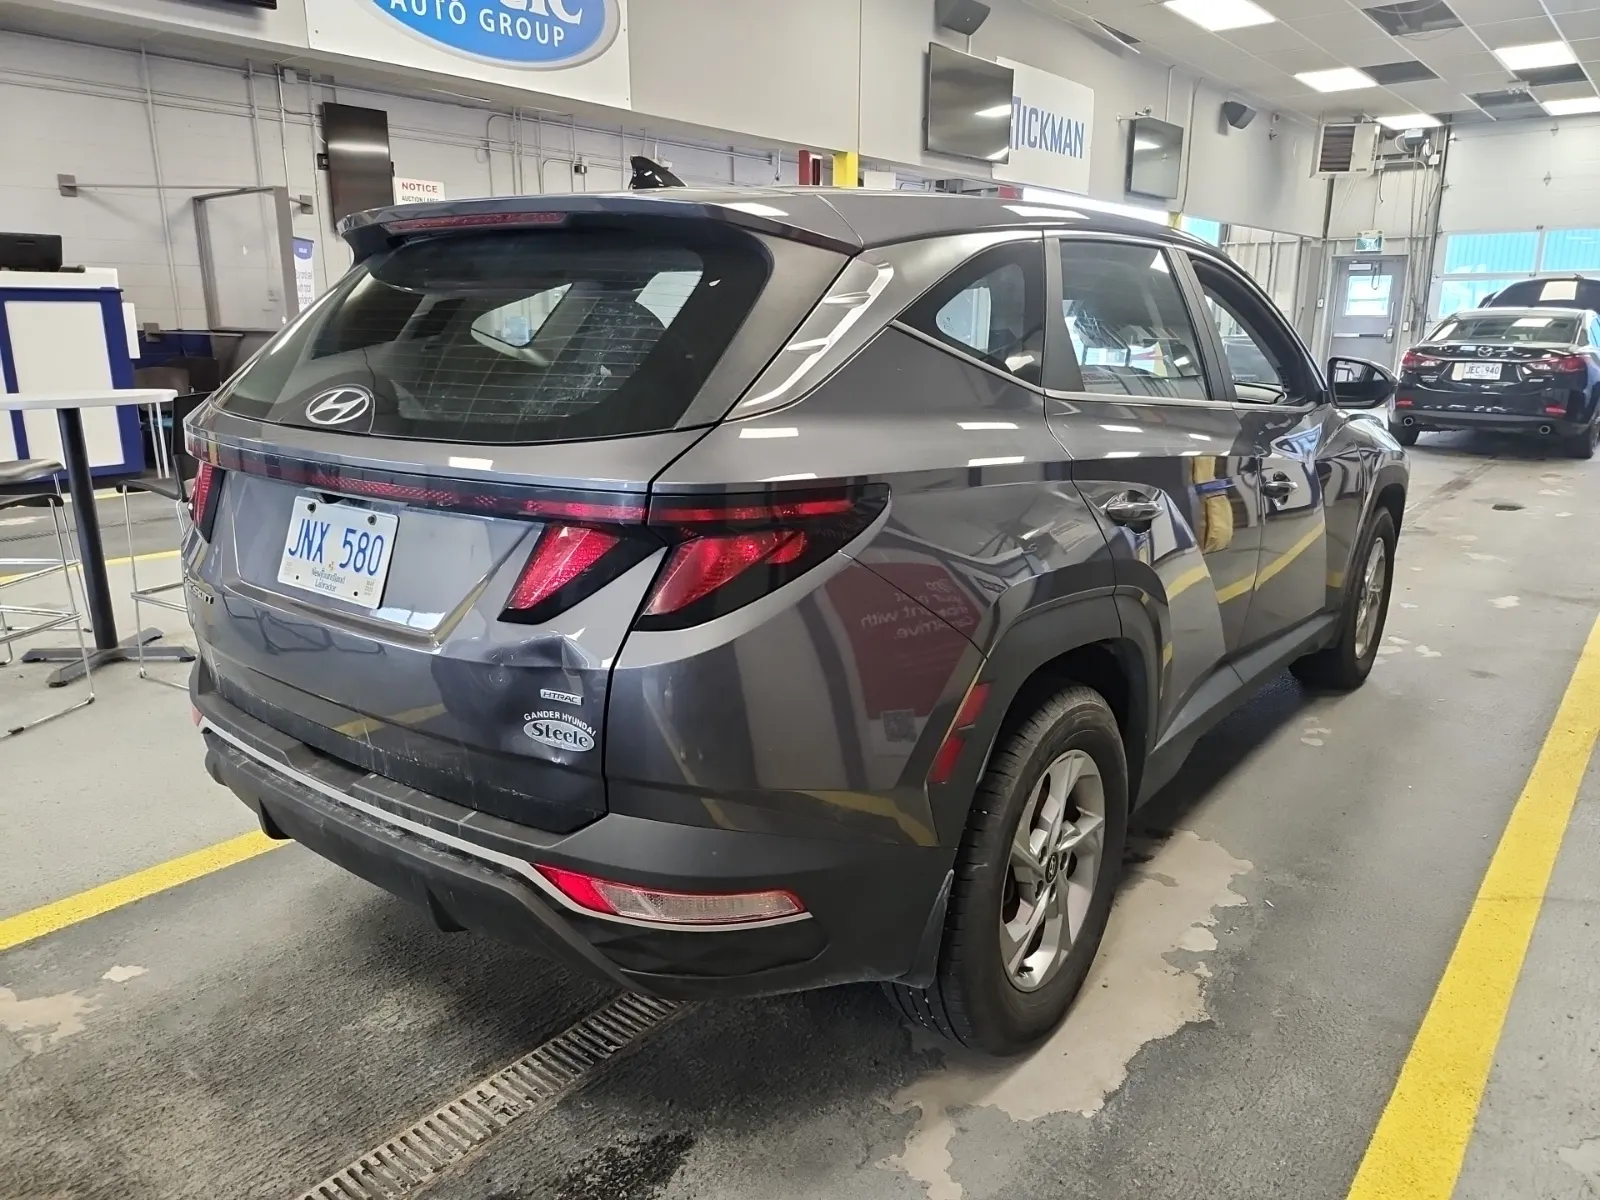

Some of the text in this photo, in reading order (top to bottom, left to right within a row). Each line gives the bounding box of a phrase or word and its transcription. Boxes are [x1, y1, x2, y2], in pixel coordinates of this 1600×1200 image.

[479, 8, 565, 48] GROUP
[401, 182, 438, 194] NOTICE
[1485, 366, 1500, 375] 940
[288, 518, 384, 577] JNX 580
[543, 691, 579, 703] HTRAC
[523, 710, 597, 737] GANDER HYUNDAI
[531, 722, 589, 748] Steele
